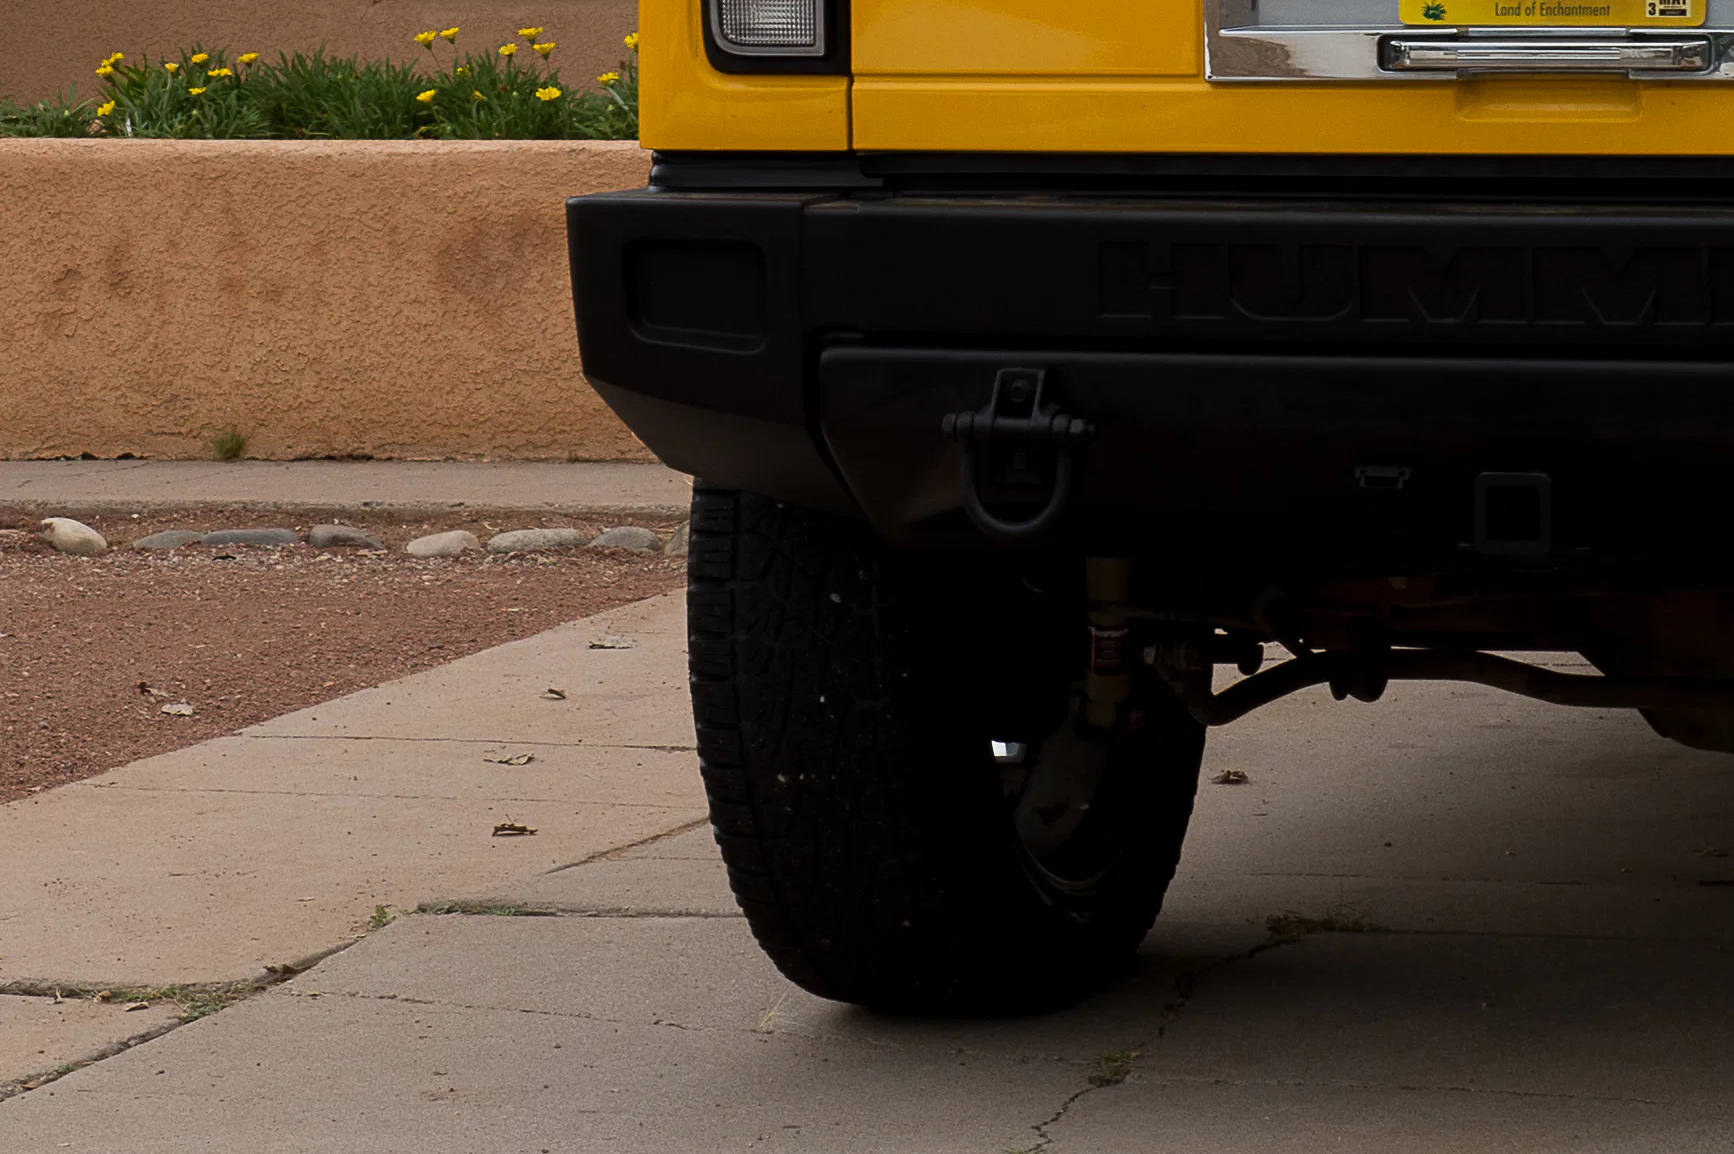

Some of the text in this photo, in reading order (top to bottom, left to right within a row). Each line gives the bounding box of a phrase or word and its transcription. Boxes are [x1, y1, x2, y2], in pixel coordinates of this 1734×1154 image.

[1495, 2, 1611, 17] Land of Enchantment
